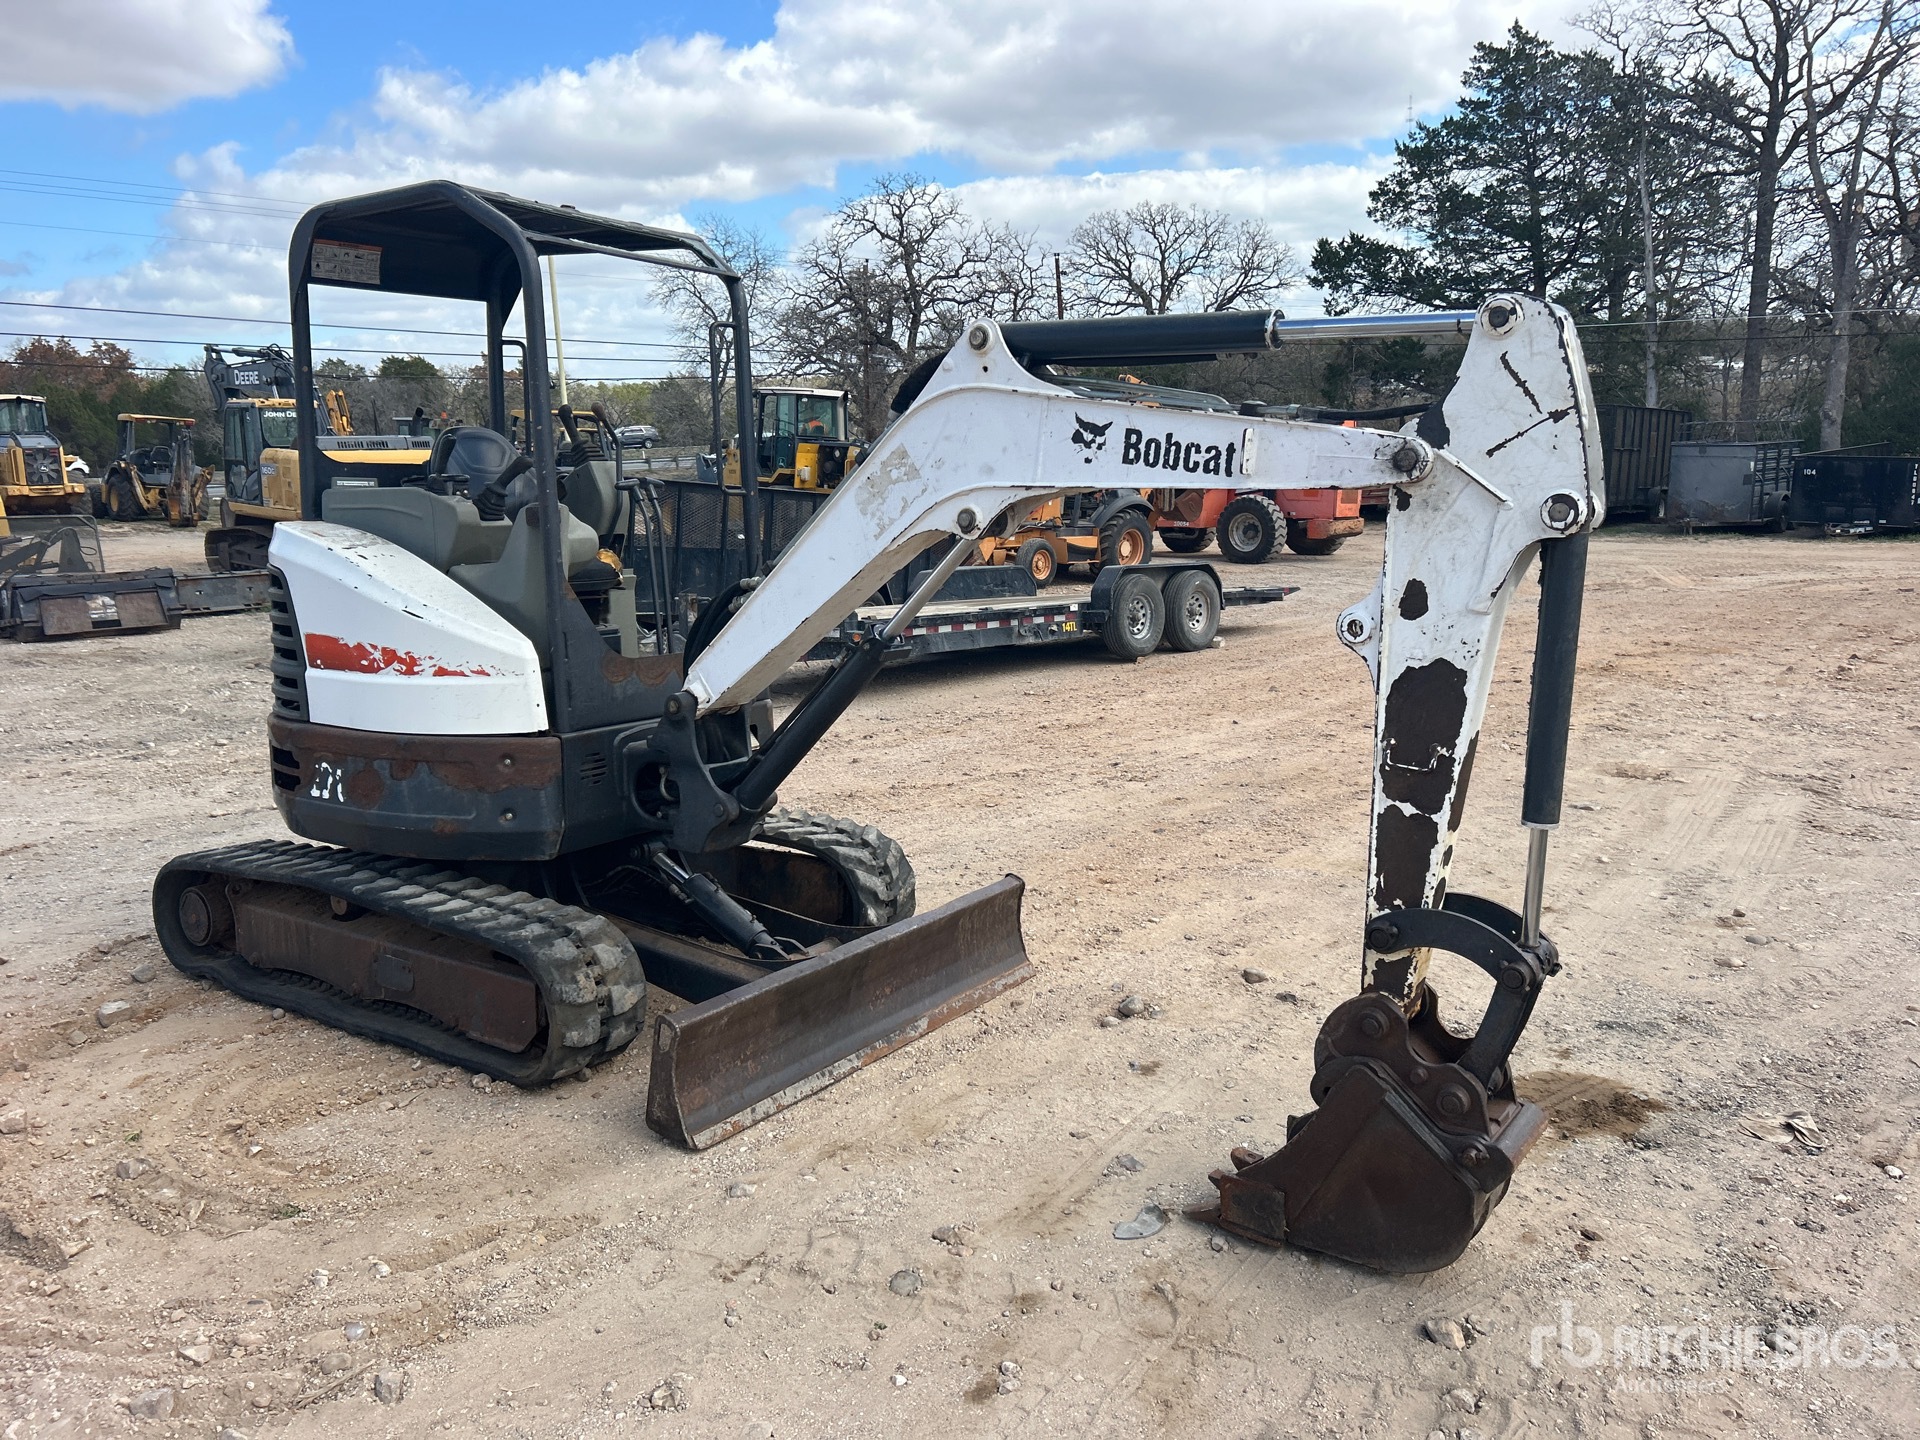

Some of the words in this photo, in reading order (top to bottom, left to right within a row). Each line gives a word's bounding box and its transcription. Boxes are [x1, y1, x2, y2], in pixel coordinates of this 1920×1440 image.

[234, 370, 259, 385] DEERE
[263, 410, 285, 418] JOHN
[1122, 427, 1237, 477] Bobcat
[1062, 621, 1077, 632] 14TL
